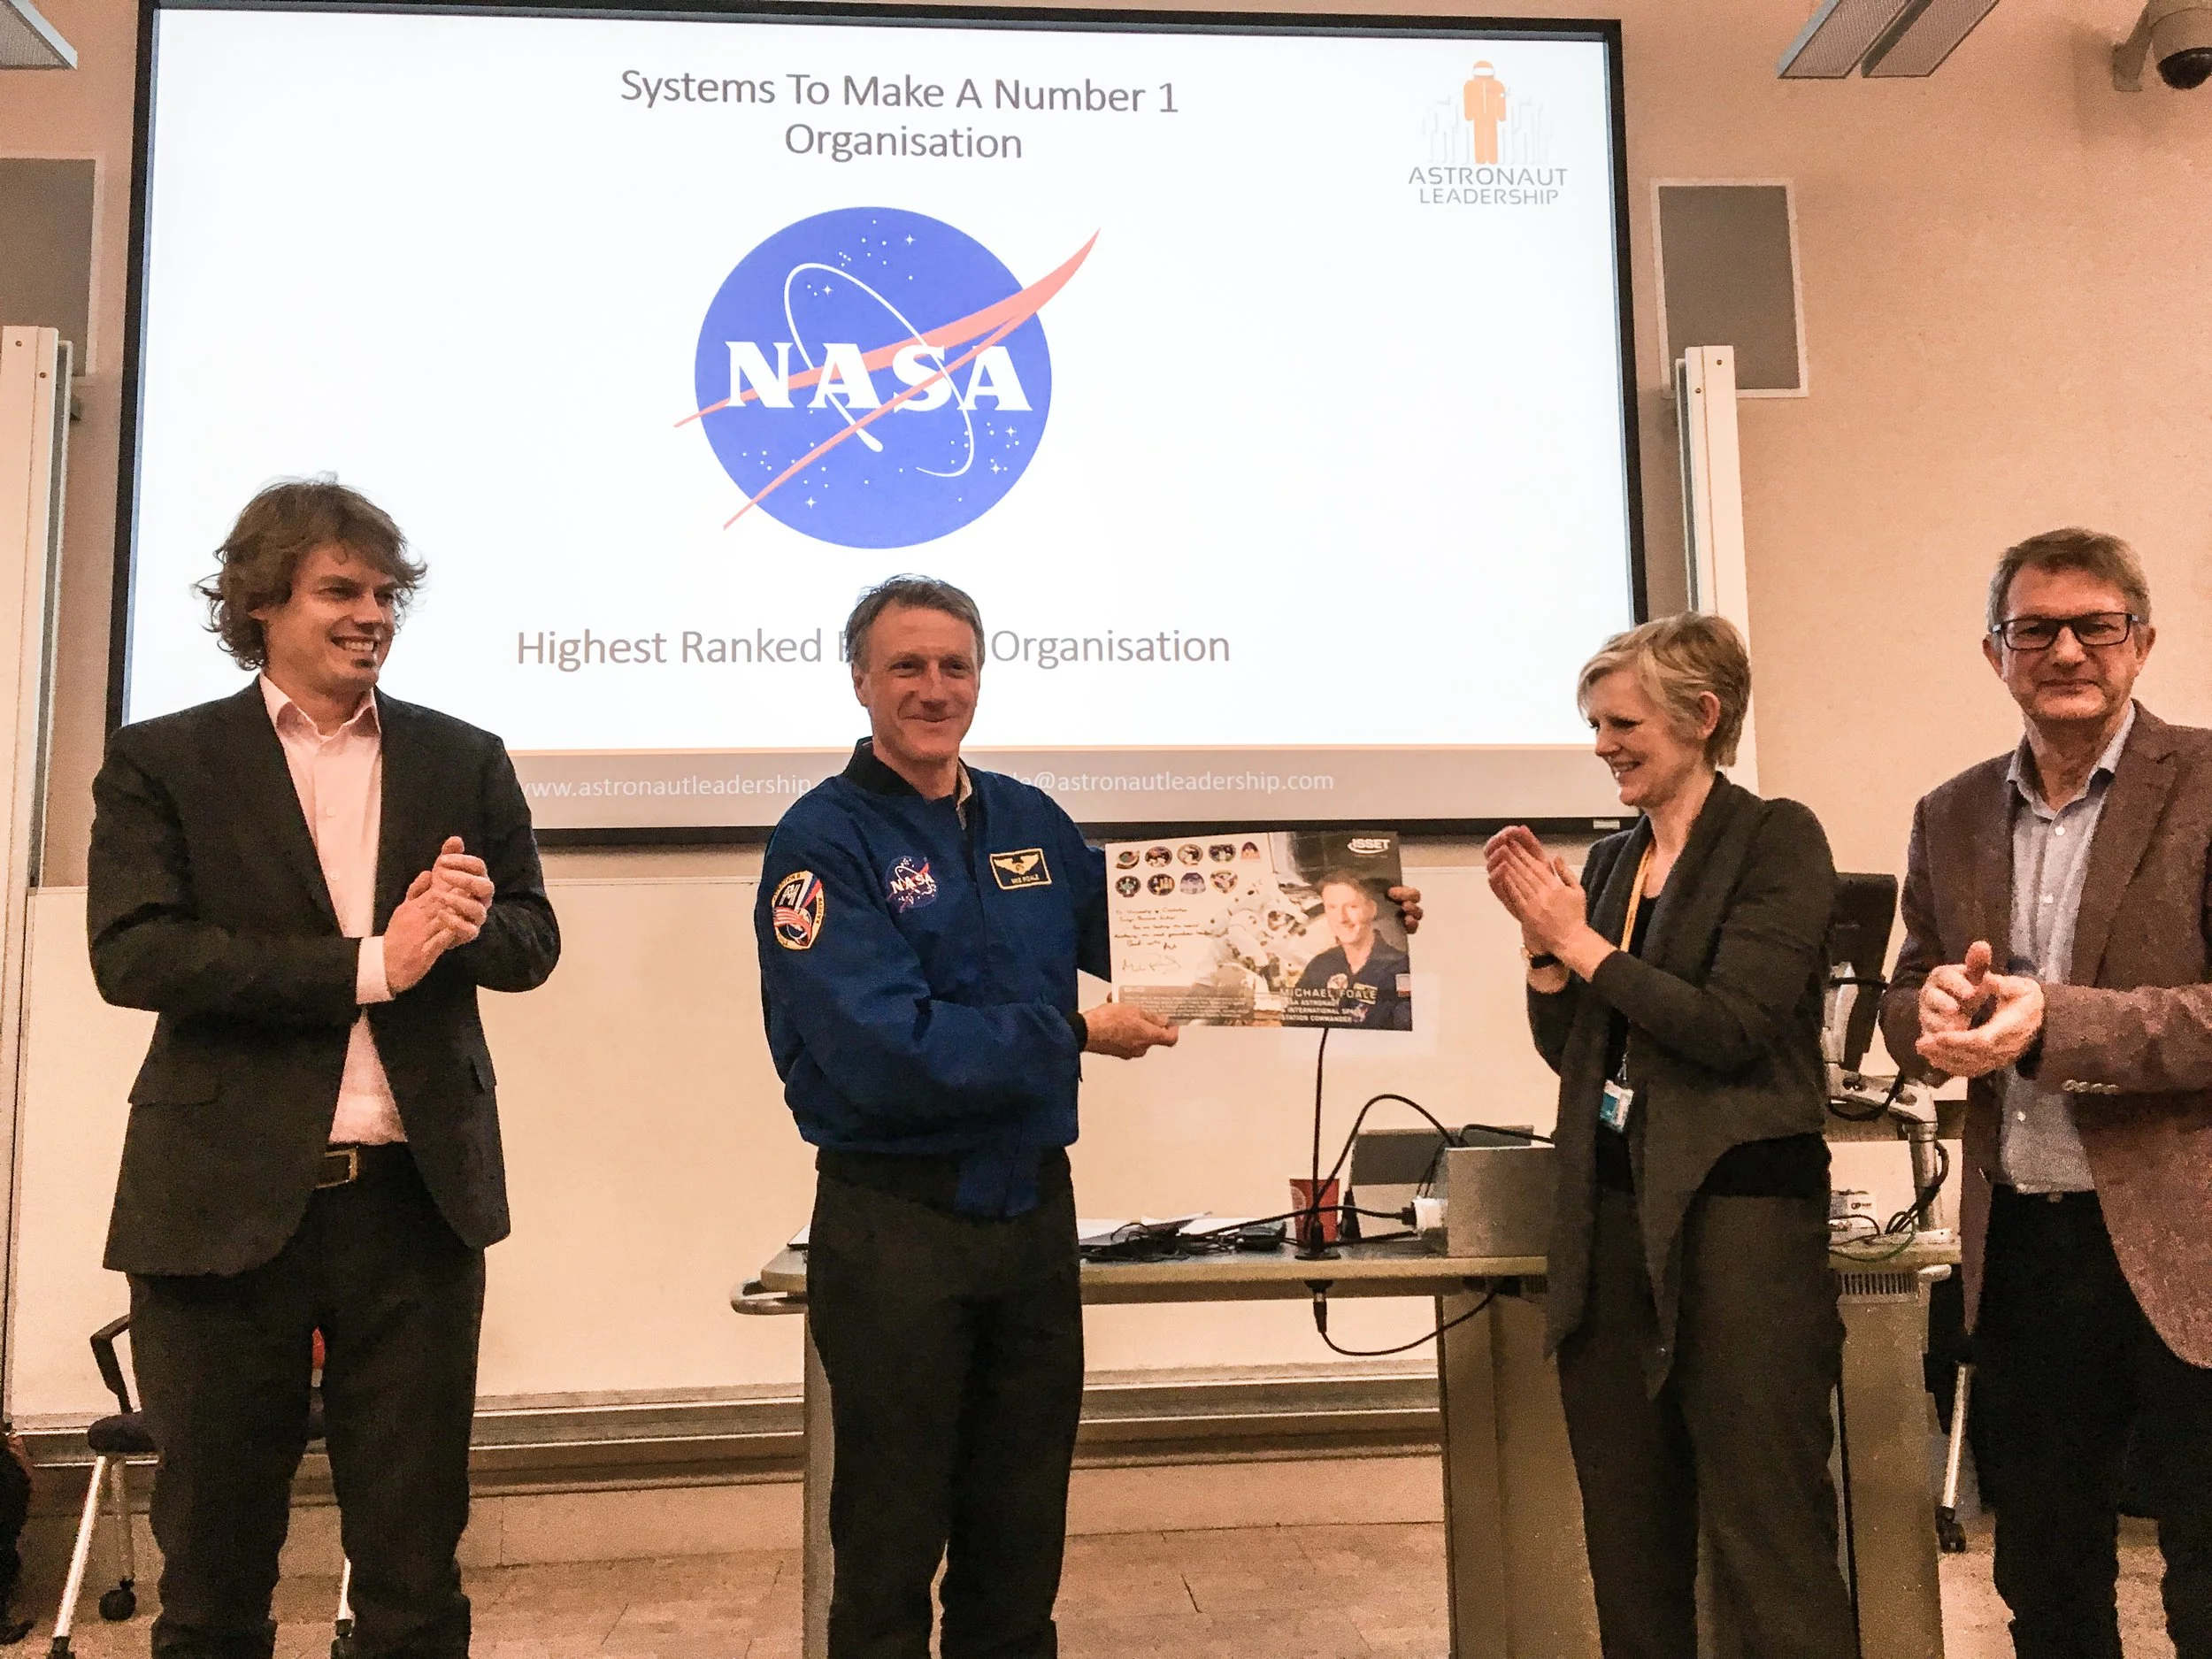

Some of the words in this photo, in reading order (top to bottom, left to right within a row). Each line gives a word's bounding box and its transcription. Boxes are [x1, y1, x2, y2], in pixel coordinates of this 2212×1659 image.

[620, 69, 776, 109] Systems
[785, 73, 830, 105] To
[843, 73, 945, 108] Make
[955, 78, 983, 110] A
[995, 78, 1147, 112] Number
[1158, 82, 1179, 113] 1
[785, 123, 1022, 164] Organisation
[1408, 166, 1568, 187] ASTRONAUT
[1419, 188, 1559, 205] LEADERSHIP
[725, 341, 1033, 412] NASA
[518, 628, 667, 672] Highest
[682, 627, 822, 664] Ranked
[991, 629, 1230, 671] Organisation
[889, 872, 935, 895] NASA
[1279, 987, 1334, 999] MICHAEL
[1339, 988, 1377, 1001] FOALE
